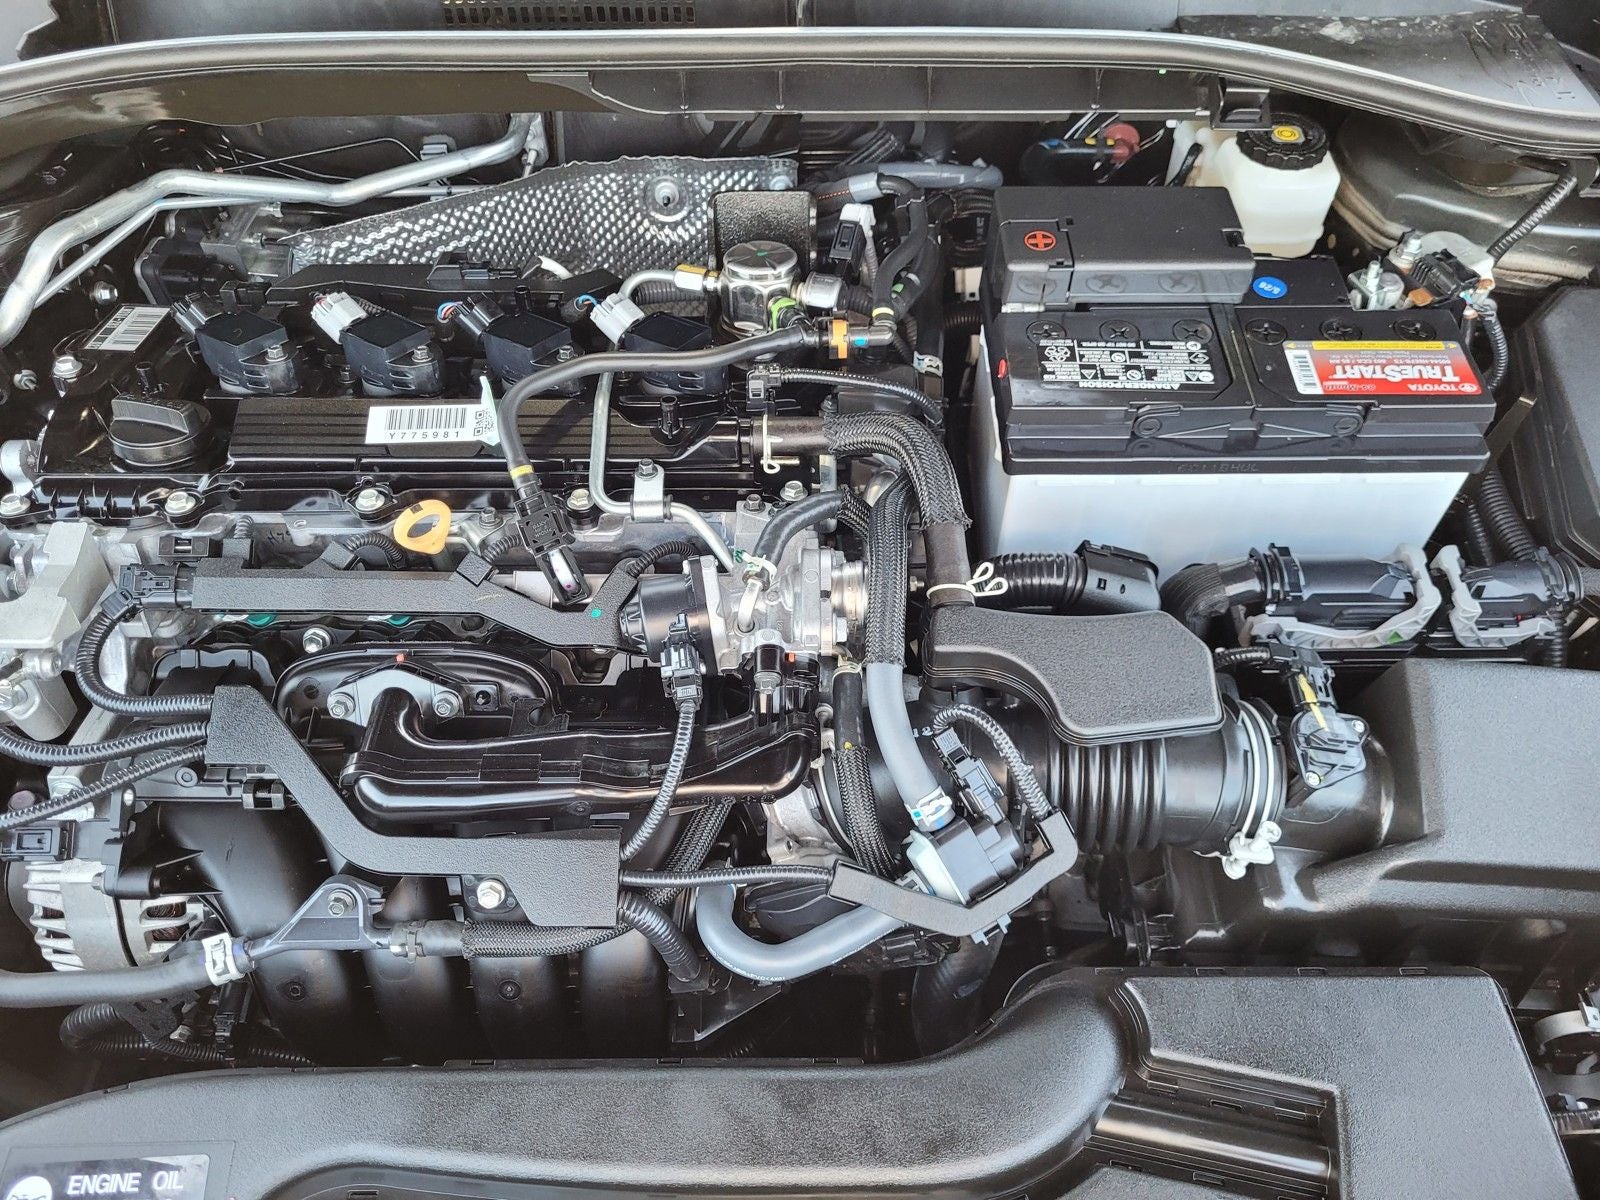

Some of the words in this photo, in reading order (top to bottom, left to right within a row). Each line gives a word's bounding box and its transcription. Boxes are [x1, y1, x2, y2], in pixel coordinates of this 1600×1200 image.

[1408, 383, 1459, 391] TOYOTA
[389, 430, 461, 440] Y775981
[66, 1172, 142, 1195] ENGINE
[152, 1170, 184, 1190] OIL
